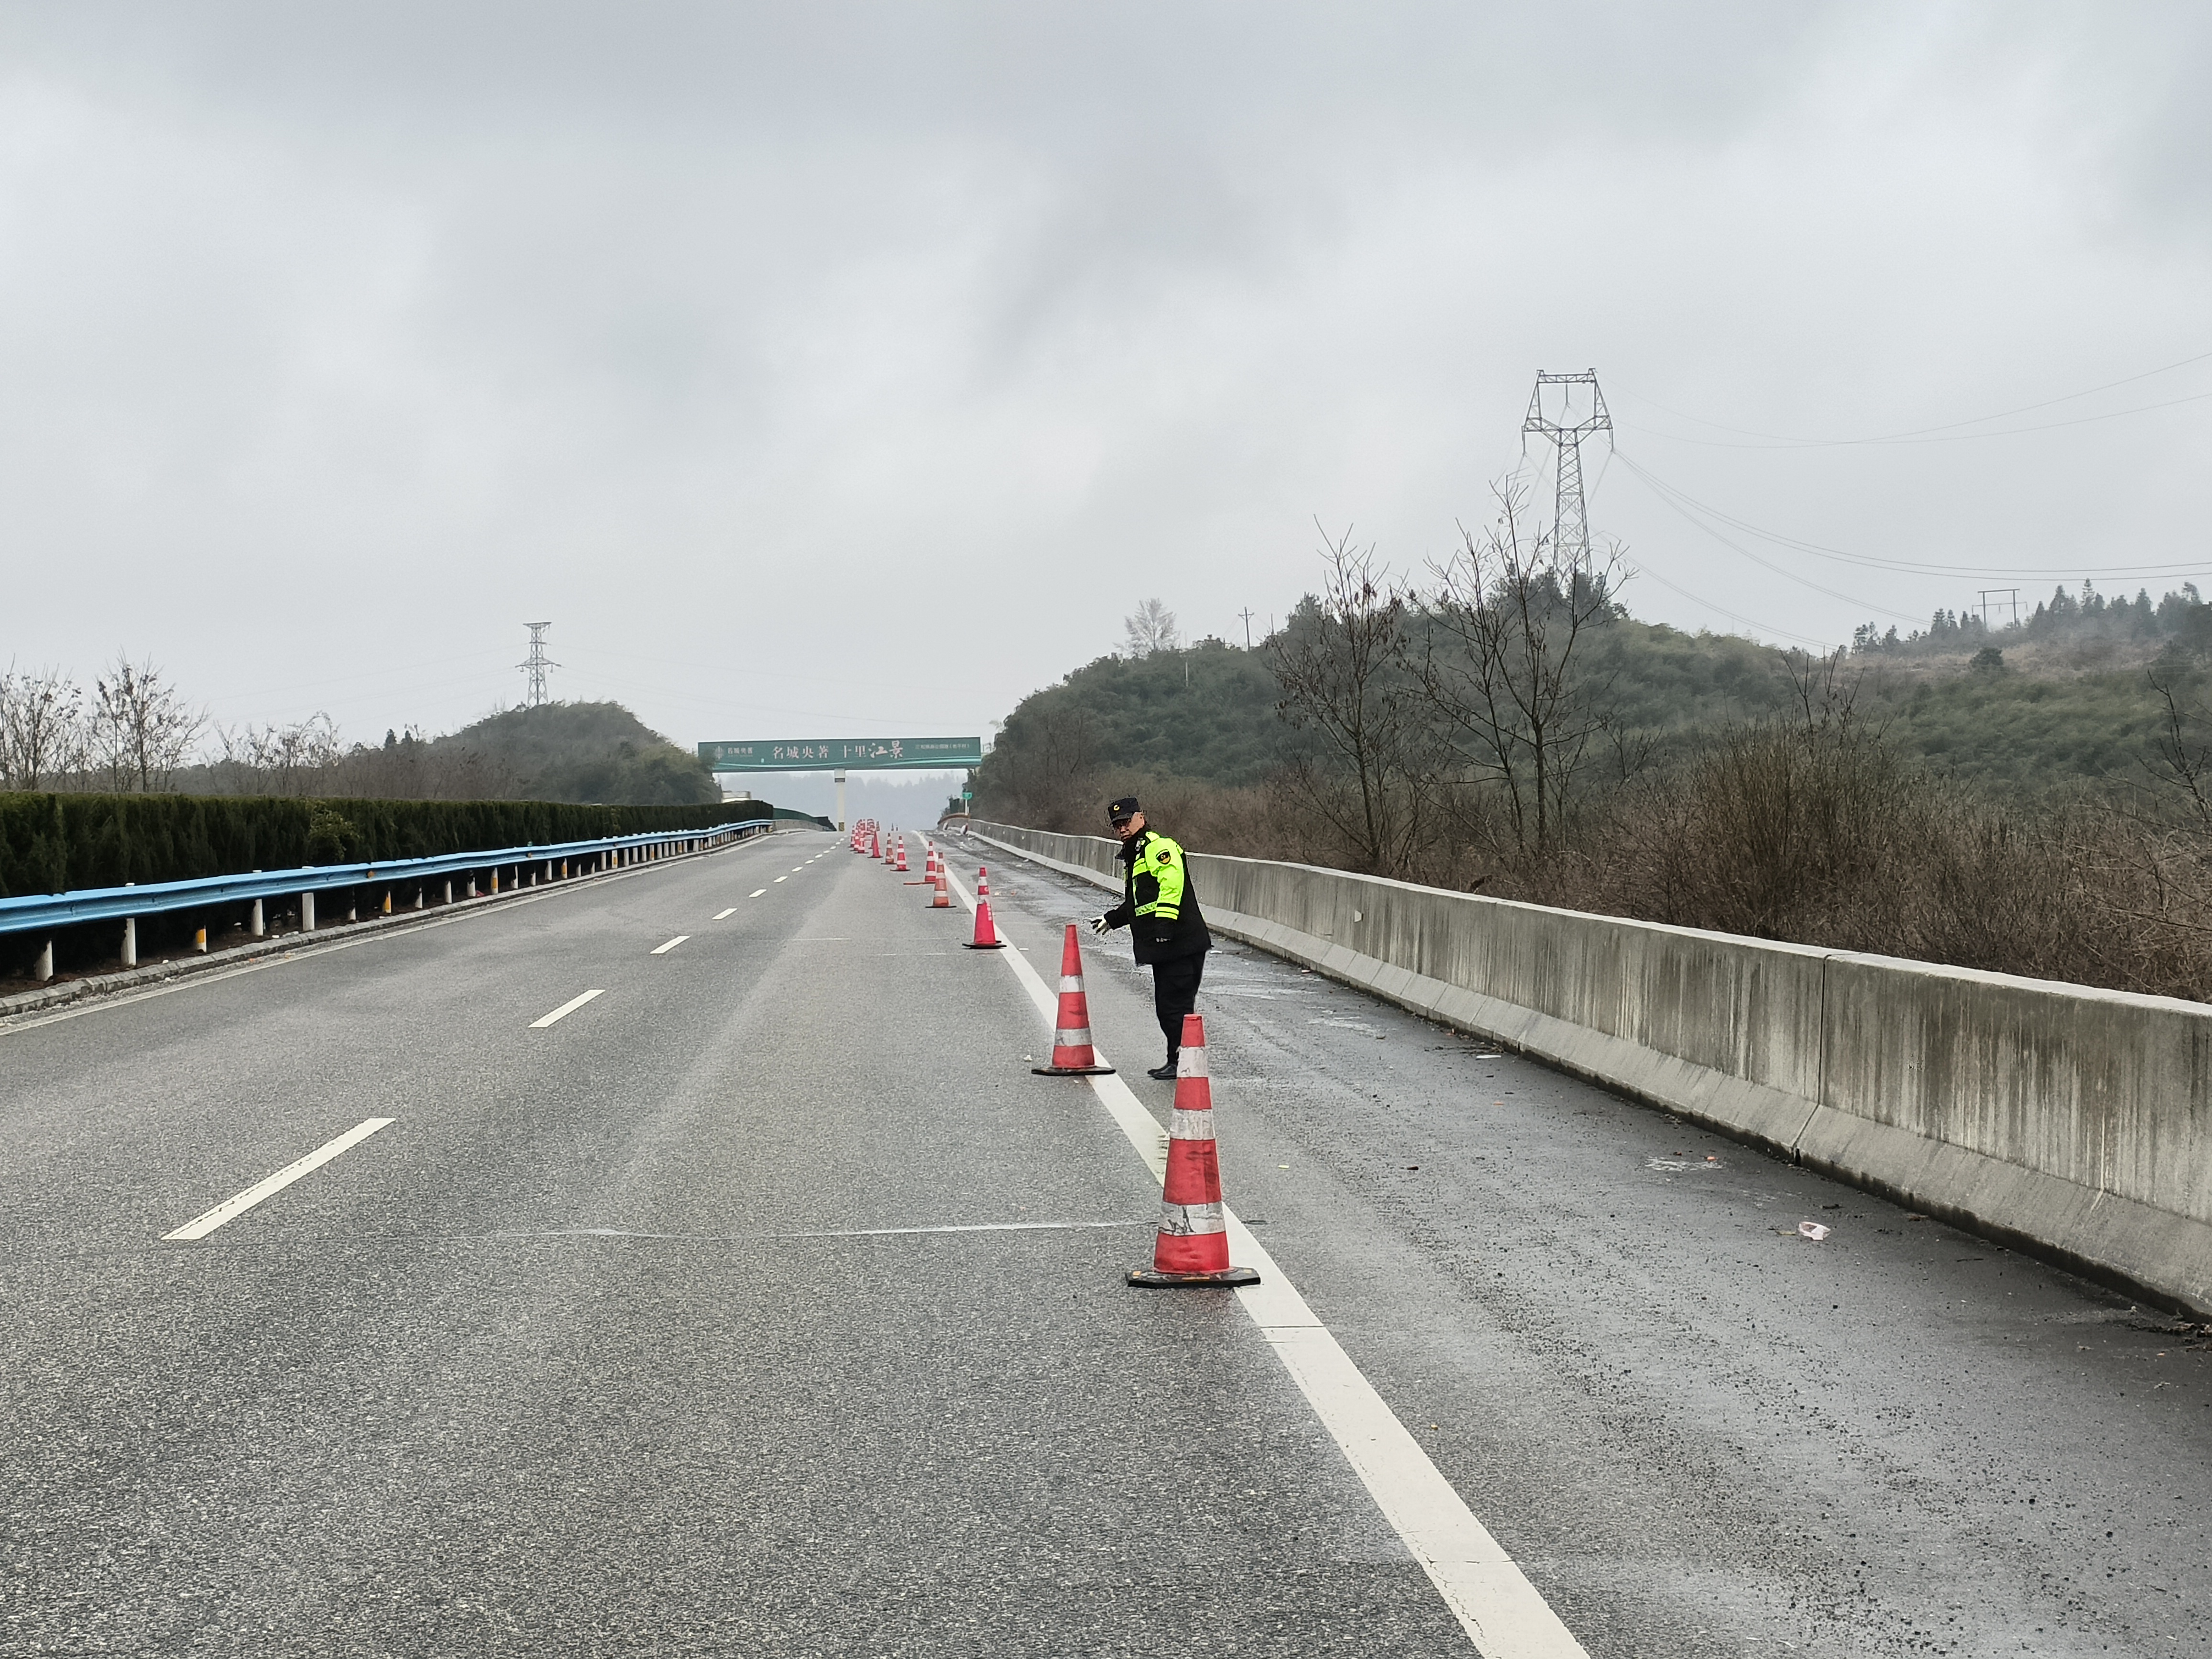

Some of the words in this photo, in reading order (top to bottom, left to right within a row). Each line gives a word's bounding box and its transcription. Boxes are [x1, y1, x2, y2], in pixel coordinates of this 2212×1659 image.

[773, 745, 829, 759] 名城央著
[841, 741, 904, 759] 十里江景
